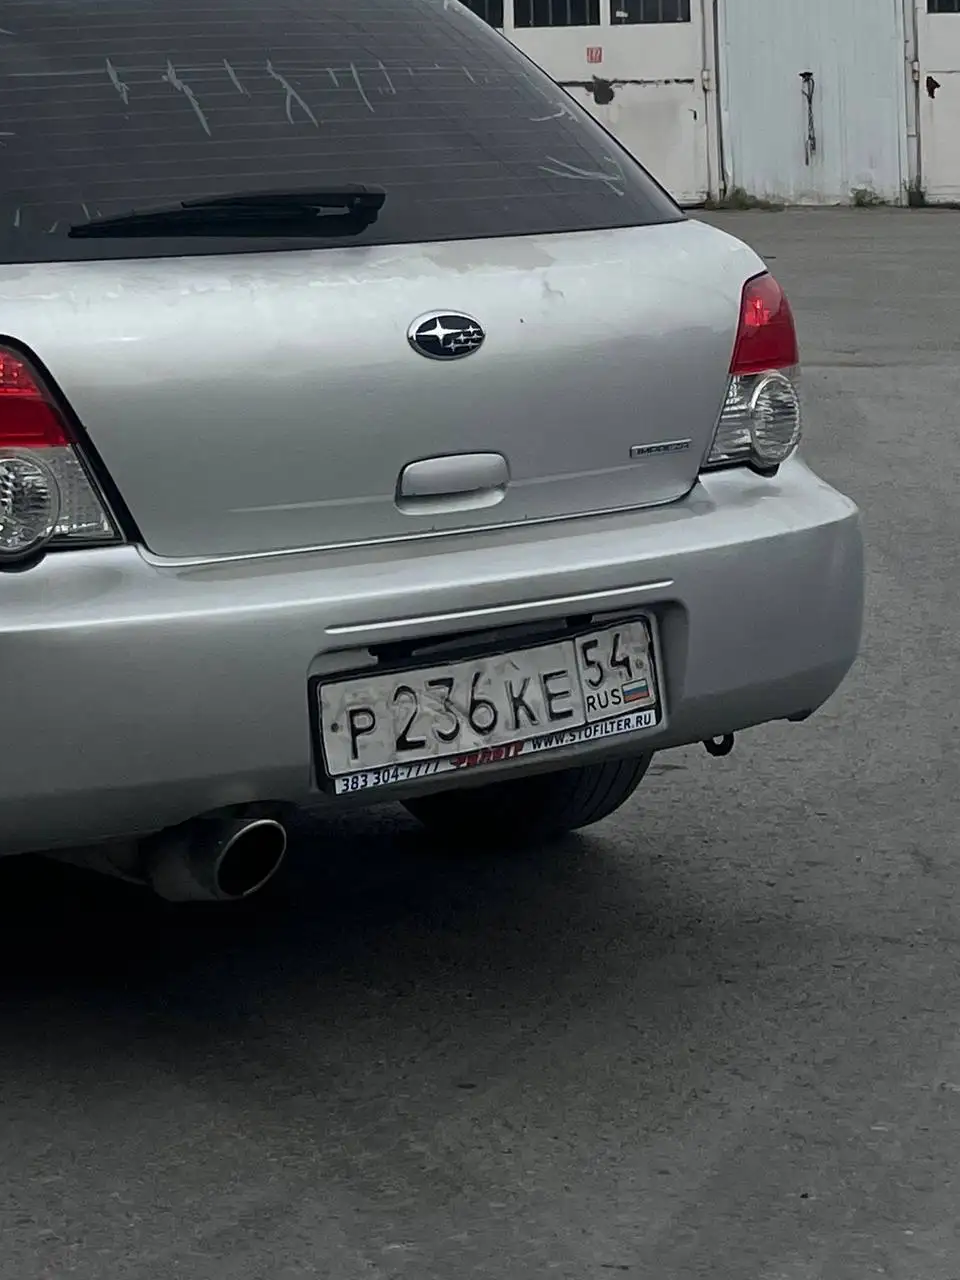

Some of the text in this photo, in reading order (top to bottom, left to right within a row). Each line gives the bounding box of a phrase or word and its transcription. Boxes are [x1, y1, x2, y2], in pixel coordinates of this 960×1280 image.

[582, 633, 632, 687] 54
[586, 688, 622, 713] RUS
[530, 714, 651, 750] WWW.STOFILTER.RU
[341, 761, 440, 793] 383 304-7777
